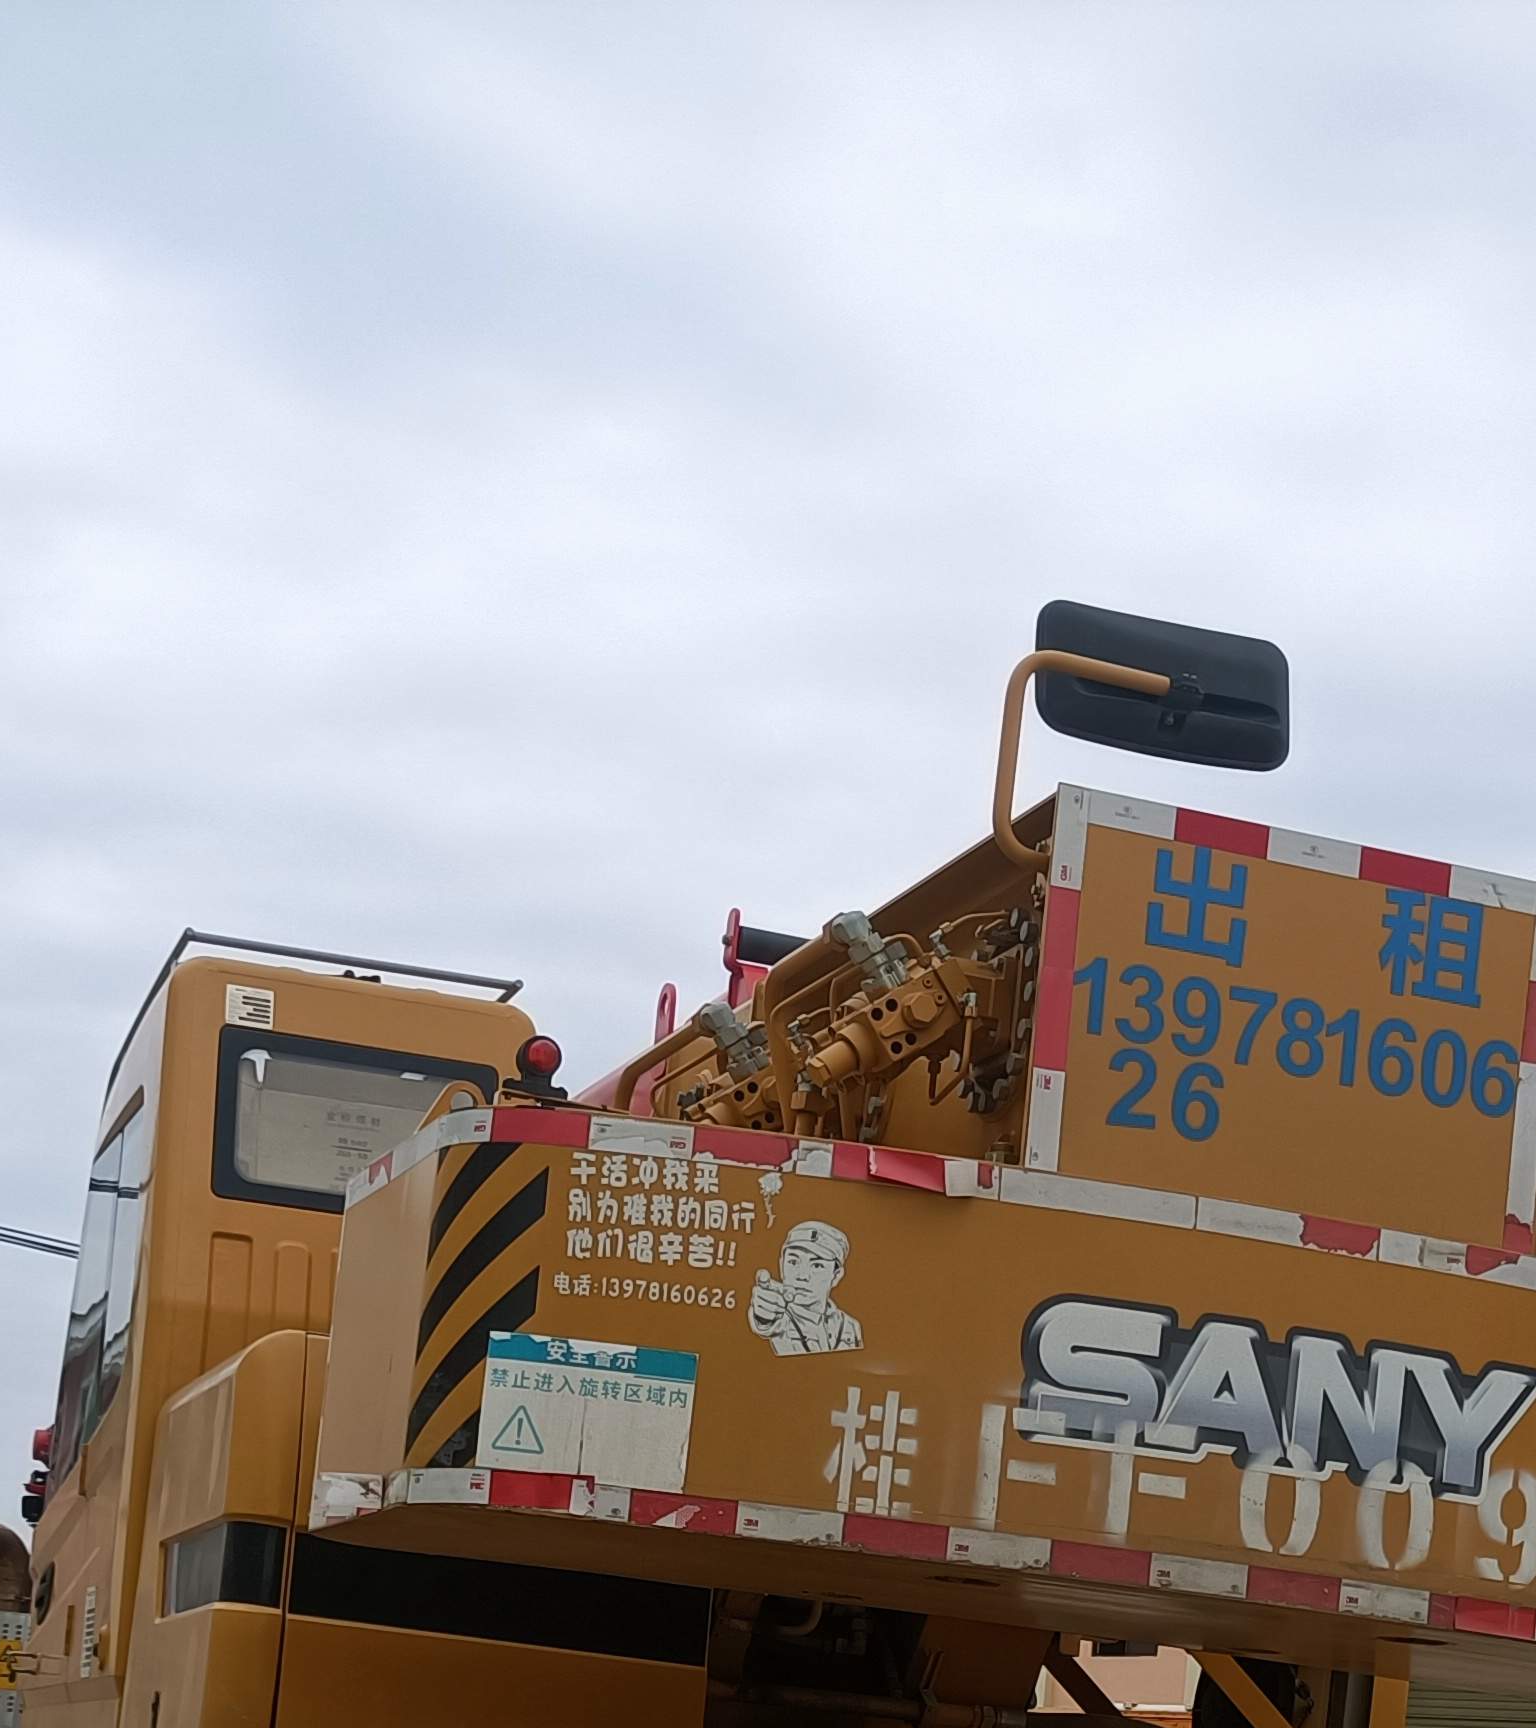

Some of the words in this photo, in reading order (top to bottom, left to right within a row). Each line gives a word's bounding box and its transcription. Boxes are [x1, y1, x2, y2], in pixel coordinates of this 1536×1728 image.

[1145, 845, 1485, 1008] 出租
[1072, 956, 1520, 1118] 139781606
[1105, 1048, 1224, 1142] 26
[570, 1152, 720, 1194] 干活冲我来
[568, 1188, 756, 1234] 别为难我的同行
[488, 1367, 689, 1409] 禁止进入旋转区域内
